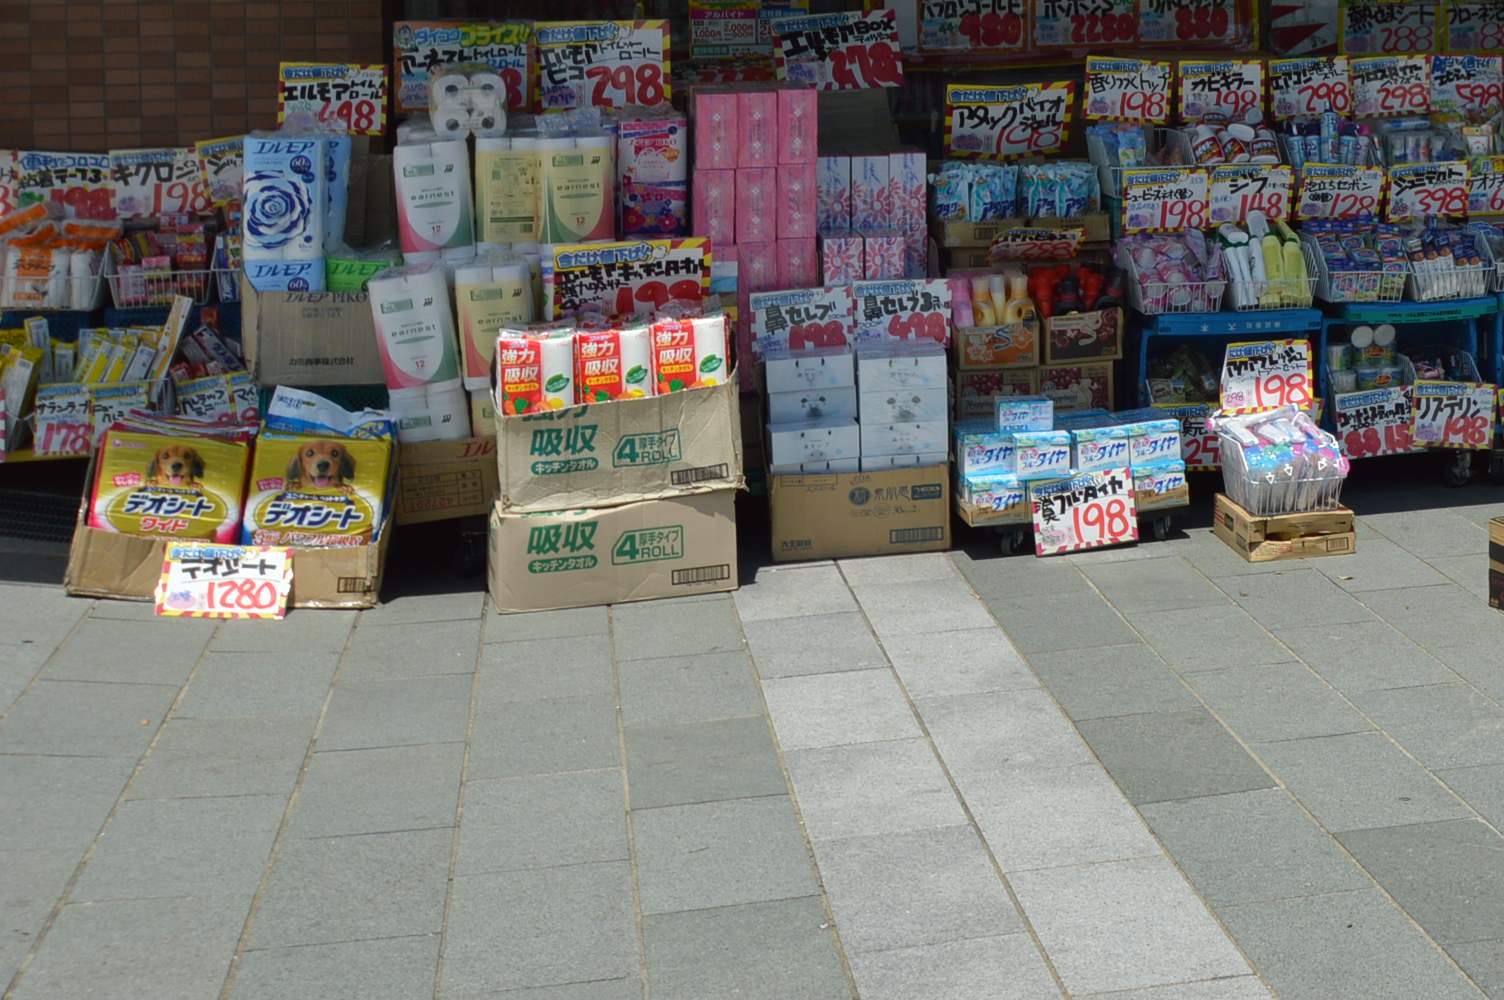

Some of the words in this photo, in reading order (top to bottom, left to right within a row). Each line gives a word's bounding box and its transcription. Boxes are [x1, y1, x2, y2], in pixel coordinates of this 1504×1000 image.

[1380, 25, 1434, 53] 288
[585, 63, 665, 107] 298
[1297, 81, 1350, 113] 298
[1377, 83, 1430, 111] 298
[1119, 89, 1165, 118] 198
[996, 124, 1061, 155] 198
[1159, 200, 1207, 230] 198
[1330, 192, 1376, 217] 128
[580, 340, 615, 357] 強力
[655, 329, 690, 347] 強力
[500, 347, 535, 364] 強力
[585, 359, 619, 376] 吸収
[659, 347, 693, 364] 吸収
[504, 366, 539, 383] 吸収
[1254, 373, 1313, 409] 198
[529, 423, 599, 457] 吸収
[616, 435, 641, 464] 4
[533, 458, 597, 475] キッチンタオル
[640, 448, 680, 464] ROLL
[123, 492, 216, 518] デオシート
[263, 500, 366, 531] デオシート
[139, 517, 188, 533] ワイド
[1070, 498, 1131, 544] 198
[526, 520, 599, 556] 吸収
[615, 532, 641, 560] 4
[640, 543, 681, 559] ROLL
[181, 558, 278, 580] デオシート
[530, 557, 596, 574] キッチンタオル
[206, 580, 278, 609] 1280
